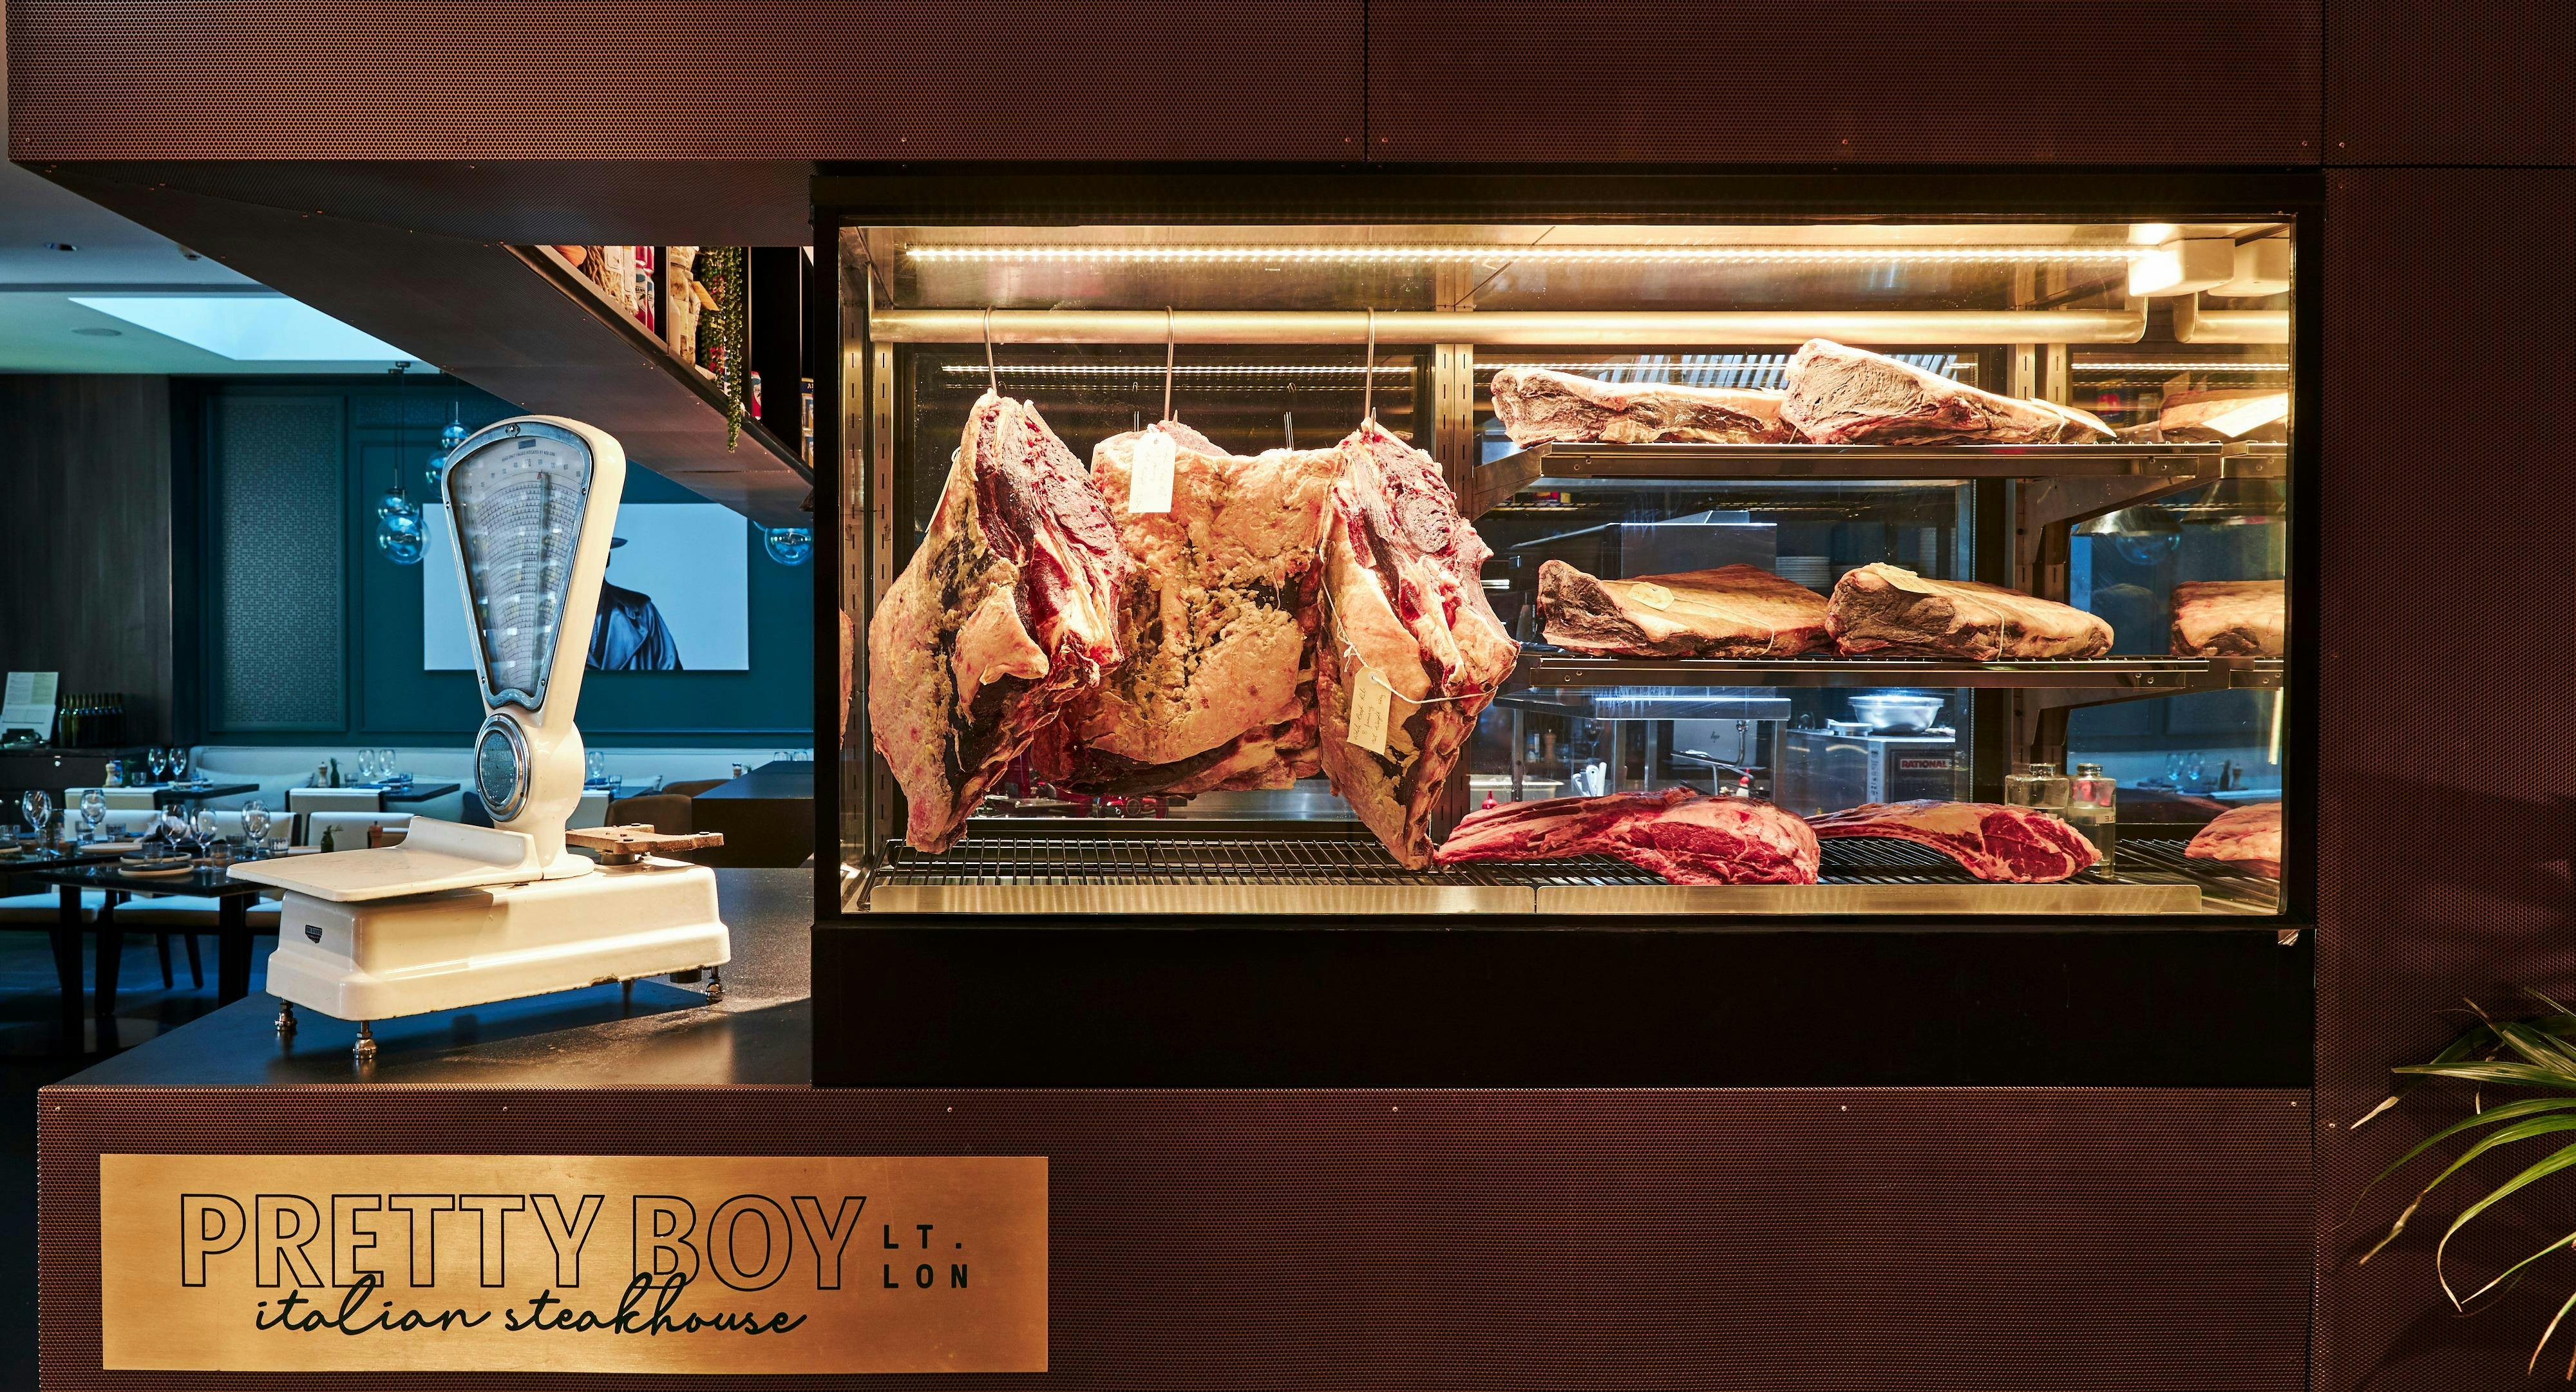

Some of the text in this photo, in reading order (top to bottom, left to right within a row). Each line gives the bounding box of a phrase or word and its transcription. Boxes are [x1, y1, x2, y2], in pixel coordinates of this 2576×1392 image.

[1710, 731, 1720, 743] hp
[1901, 760, 1947, 768] RATIONAL
[181, 1193, 866, 1292] PRETTY BOY
[884, 1224, 961, 1249] LT.
[884, 1263, 967, 1288] LON
[256, 1272, 807, 1336] italian steakhouse
